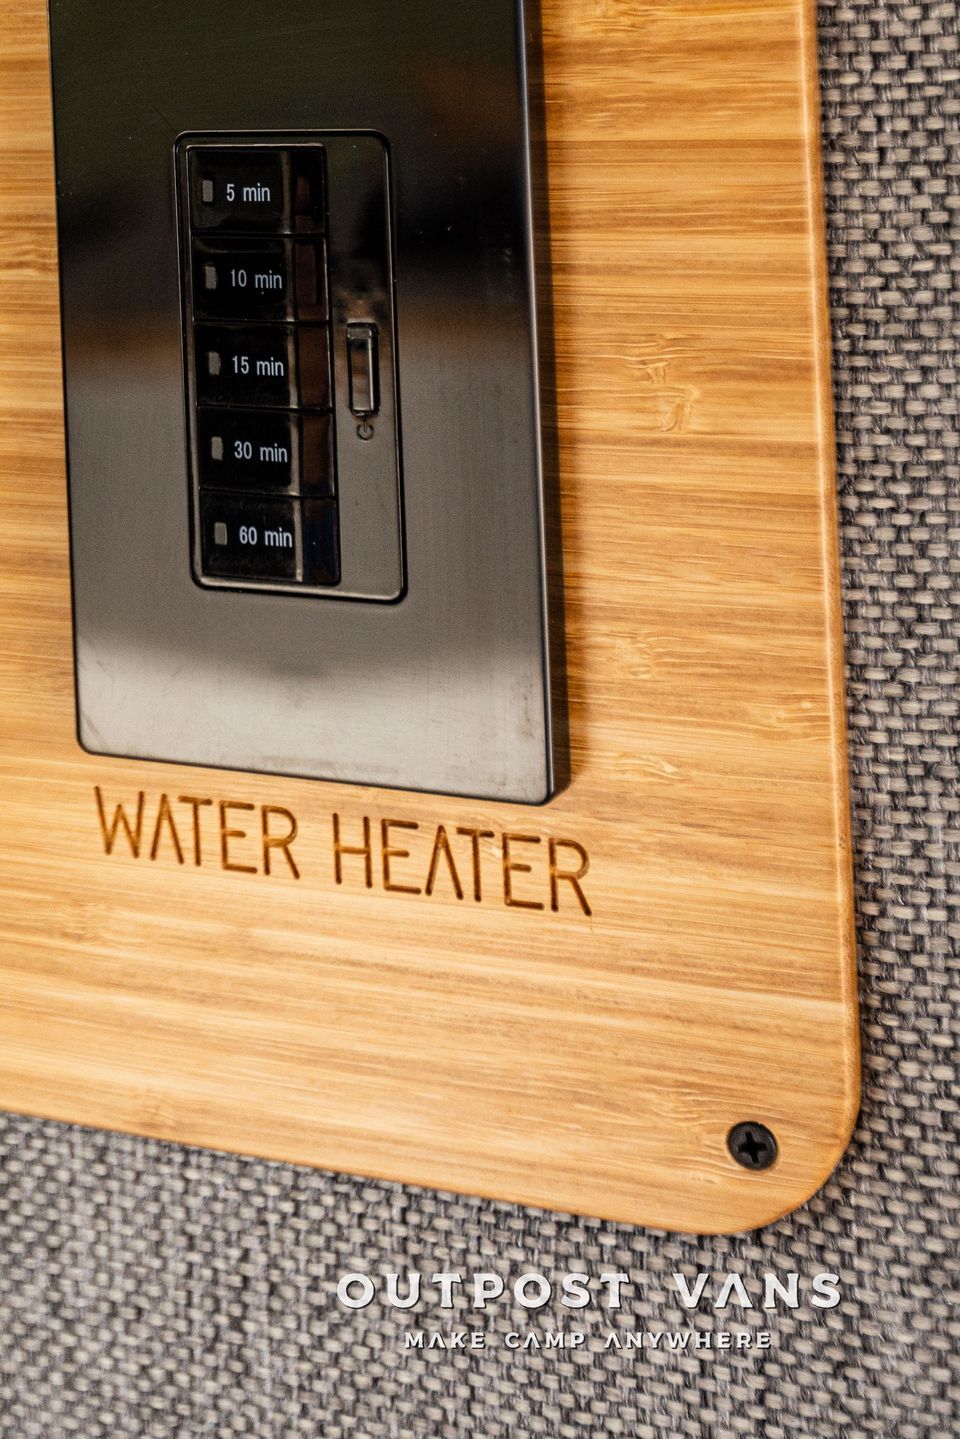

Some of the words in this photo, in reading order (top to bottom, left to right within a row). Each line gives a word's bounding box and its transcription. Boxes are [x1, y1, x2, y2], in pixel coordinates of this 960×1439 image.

[226, 183, 235, 202] 5
[243, 183, 271, 202] min
[230, 269, 247, 287] 10
[255, 271, 283, 289] min
[232, 356, 249, 374] 15
[257, 357, 284, 376] min
[234, 441, 252, 459] 30
[260, 443, 288, 462] min
[239, 526, 257, 545] 60
[265, 528, 293, 548] min
[94, 785, 300, 880] WATER
[333, 813, 593, 918] HEATER
